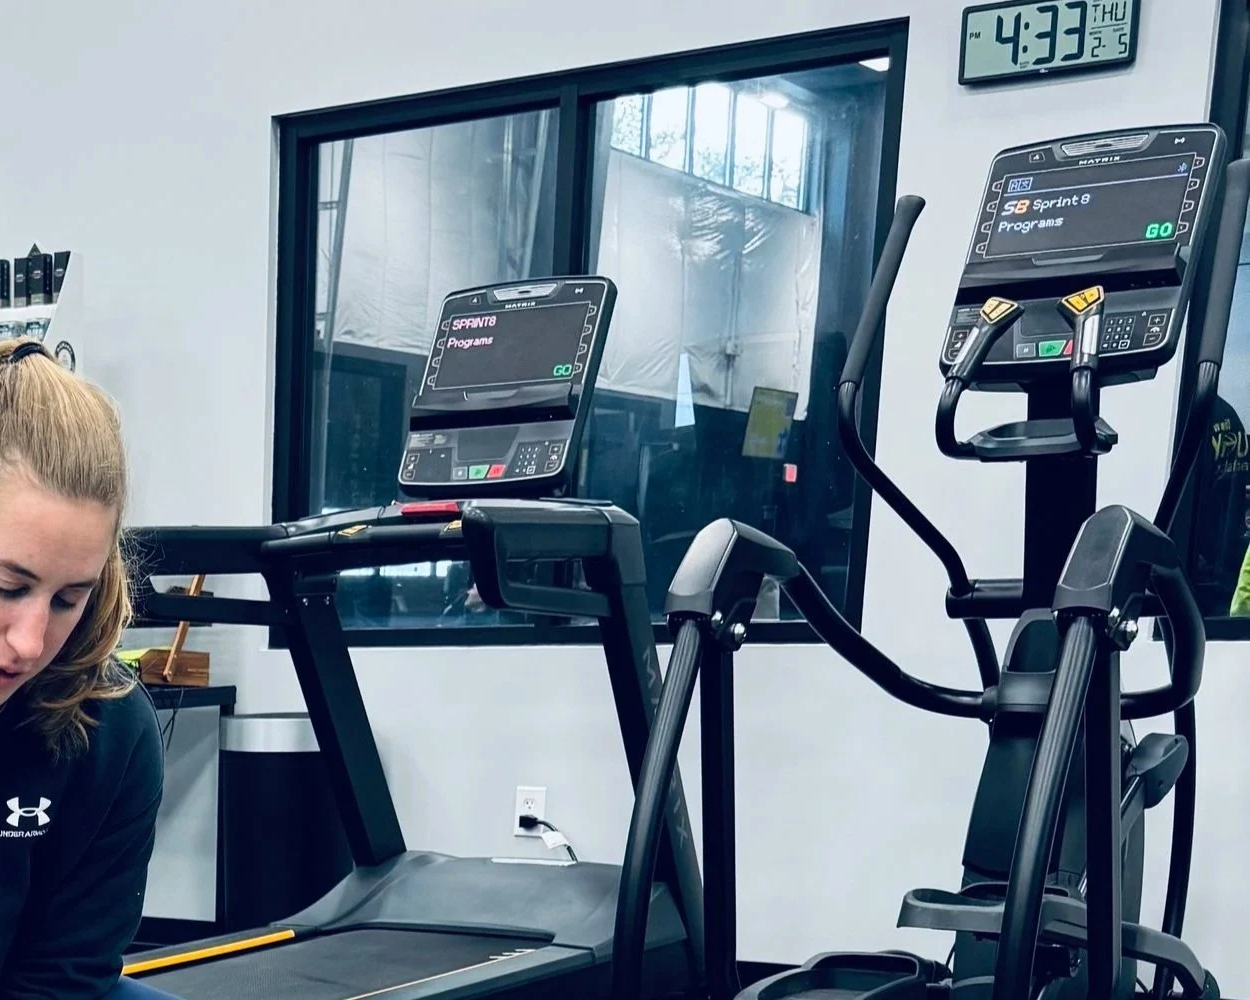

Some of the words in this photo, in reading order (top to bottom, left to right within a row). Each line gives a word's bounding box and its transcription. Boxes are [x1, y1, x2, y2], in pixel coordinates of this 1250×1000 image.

[1092, 0, 1127, 22] THU
[969, 32, 981, 40] PM
[995, 0, 1087, 66] 4:33
[1078, 155, 1121, 165] MATRIX
[998, 216, 1064, 234] Programs
[1145, 222, 1174, 239] GO
[452, 316, 496, 330] SPRINT8
[446, 336, 494, 350] Programs
[553, 364, 572, 376] GO
